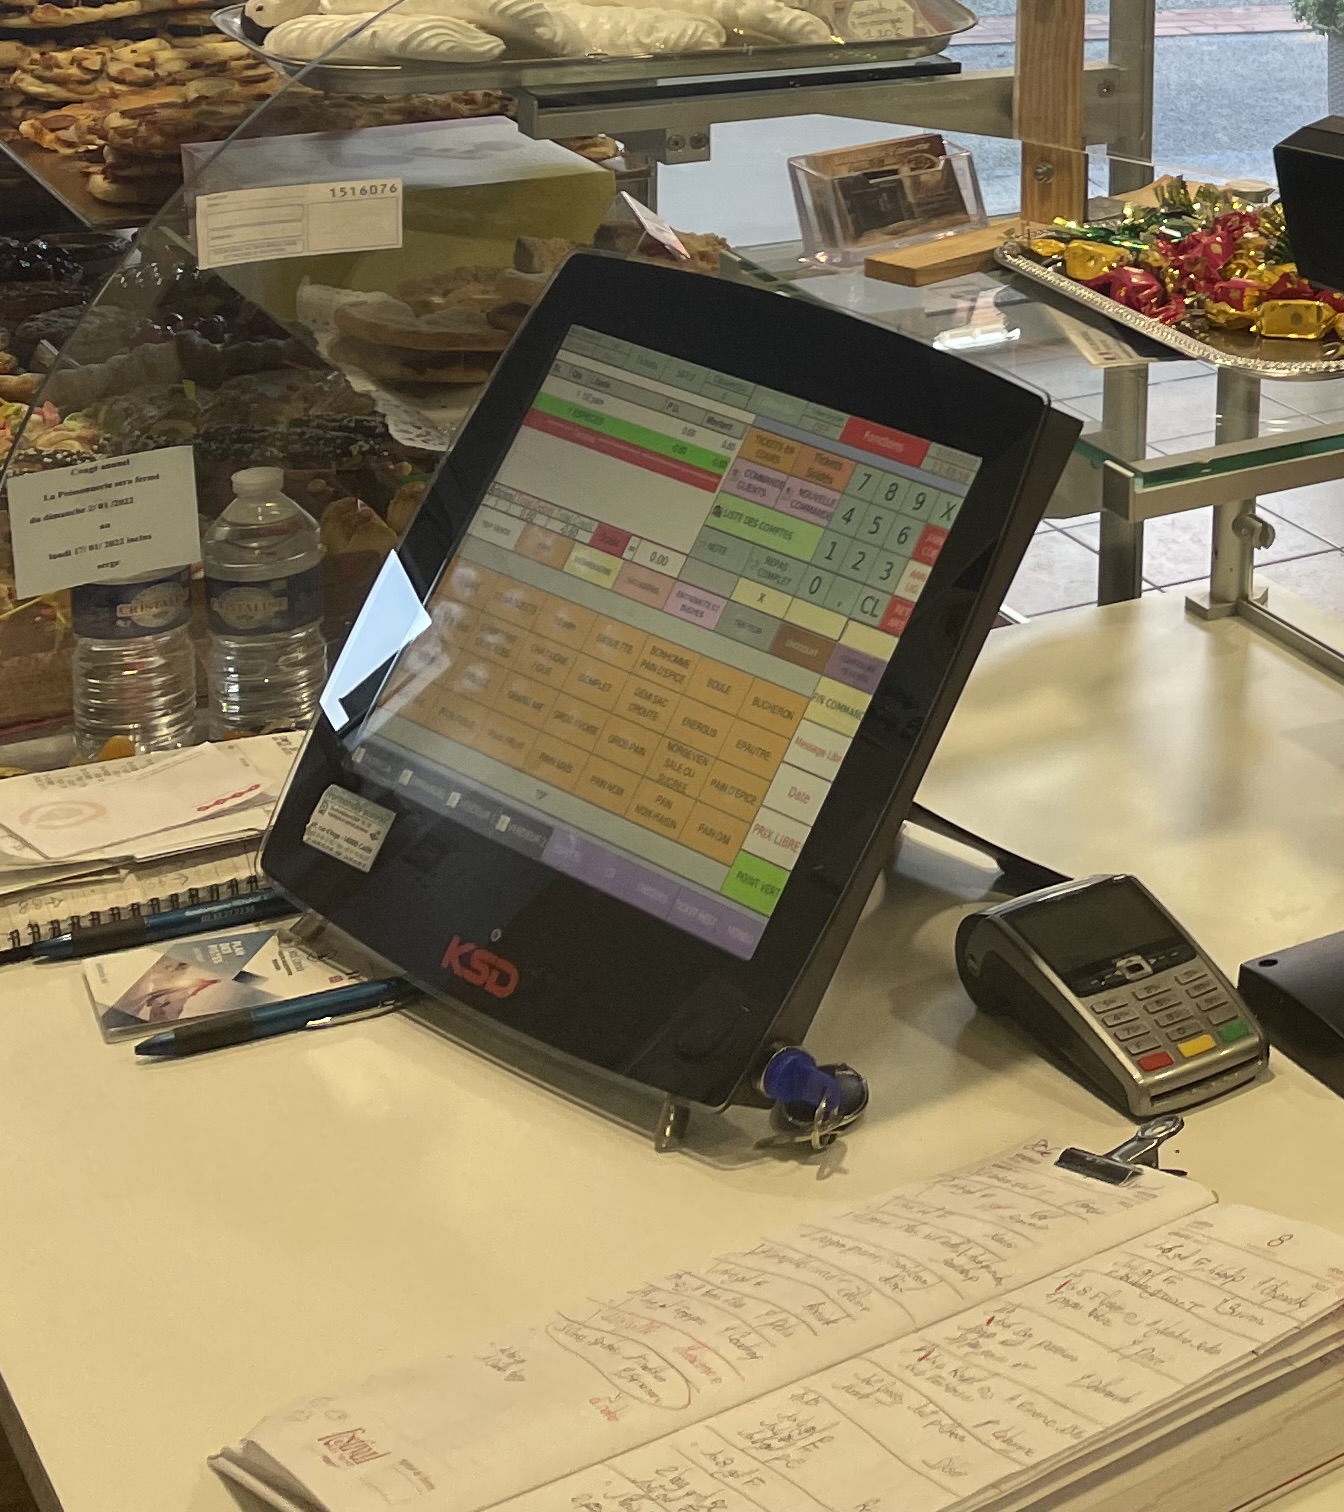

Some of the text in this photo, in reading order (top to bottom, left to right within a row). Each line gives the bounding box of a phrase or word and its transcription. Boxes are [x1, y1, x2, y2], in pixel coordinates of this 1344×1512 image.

[329, 183, 398, 199] 1516076
[857, 472, 872, 491] 7
[884, 482, 899, 502] 8
[912, 491, 928, 511] 9
[841, 506, 855, 526] 4
[939, 501, 957, 522] X
[867, 515, 883, 535] 5
[896, 525, 912, 546] 6
[649, 551, 670, 567] 0.00
[824, 540, 838, 562] 1
[850, 550, 866, 572] 2
[878, 561, 894, 581] 3
[809, 575, 823, 596] 0
[859, 595, 880, 618] CL
[786, 785, 811, 805] Date
[752, 822, 801, 853] PRIX LIBRE
[443, 937, 518, 999] KSD
